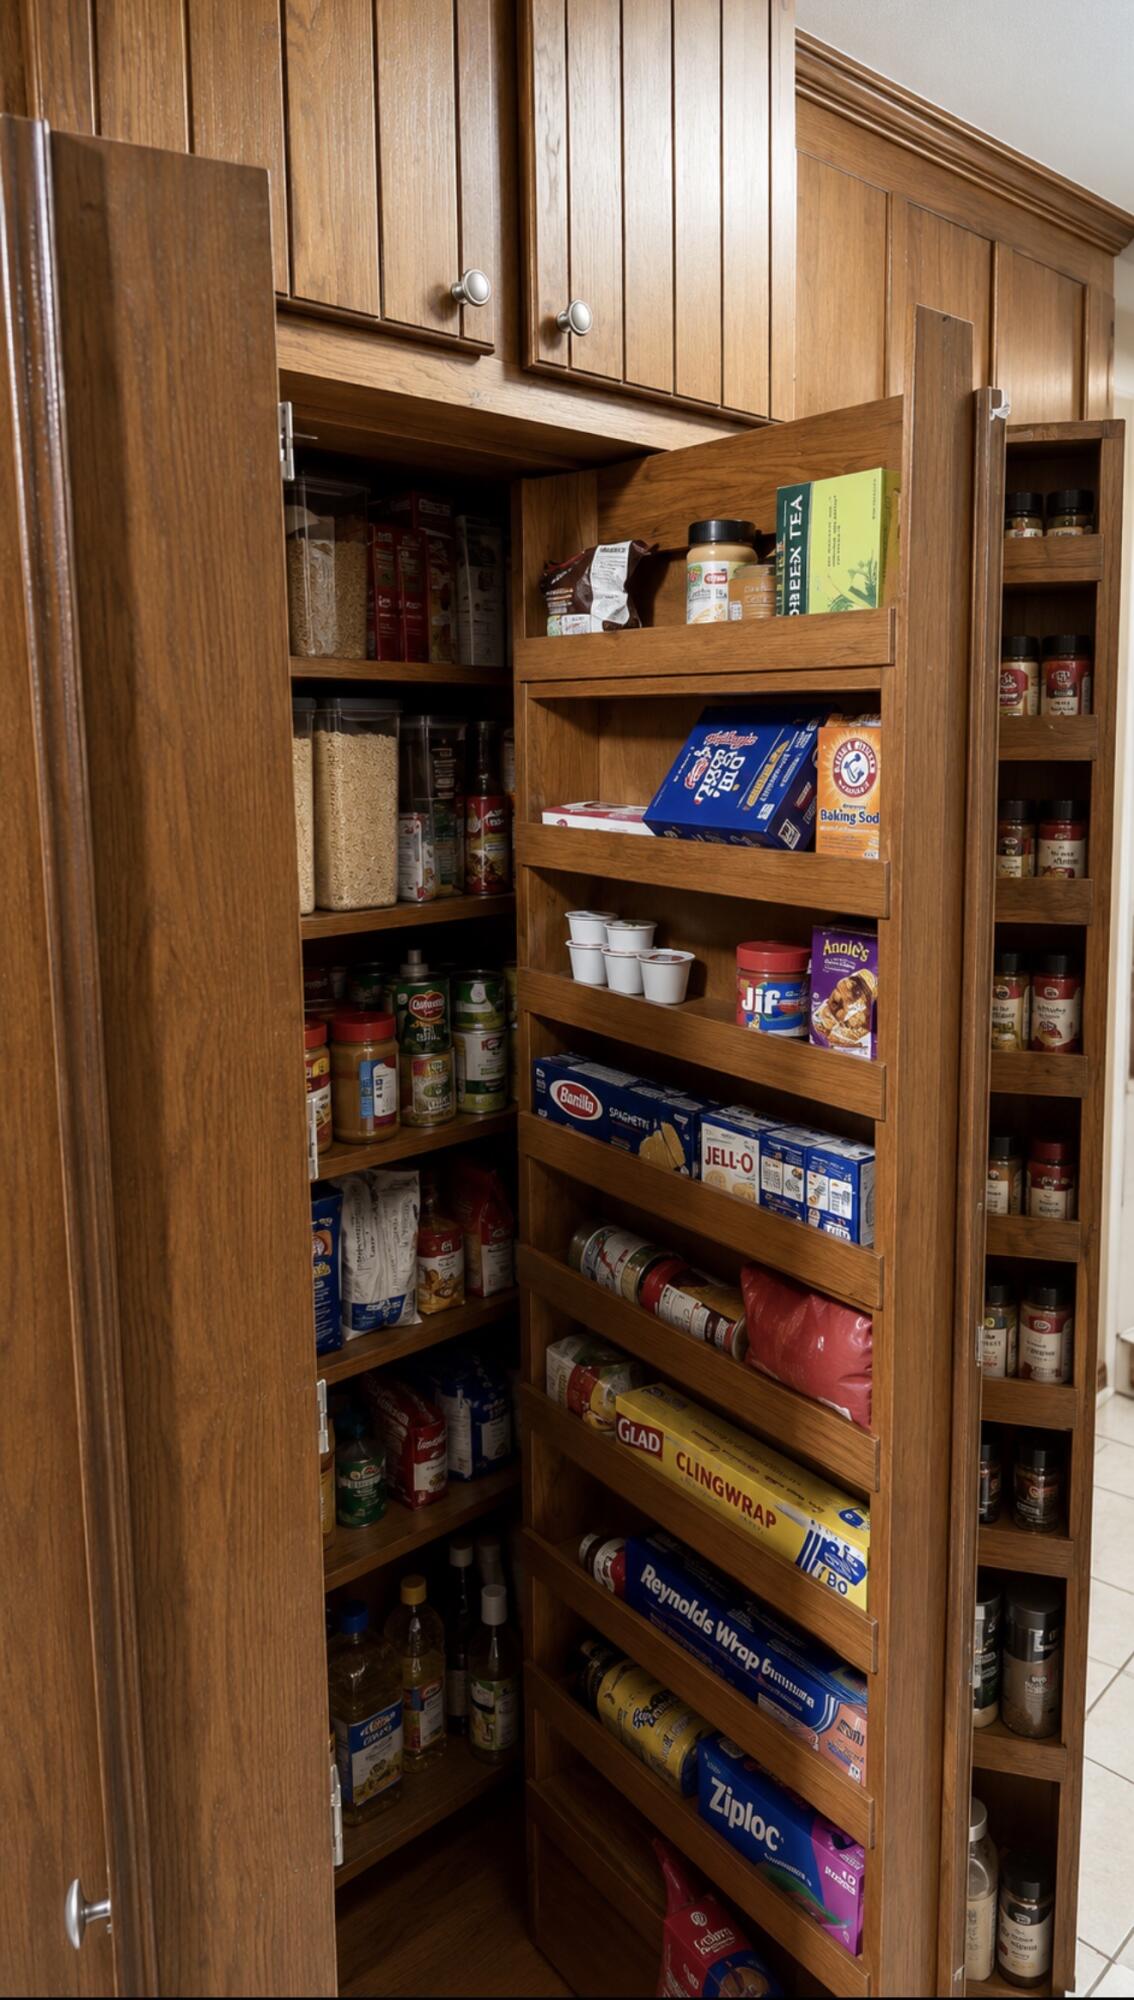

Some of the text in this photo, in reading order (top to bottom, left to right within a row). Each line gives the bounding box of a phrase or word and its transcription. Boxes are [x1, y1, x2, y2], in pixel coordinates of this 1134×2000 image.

[789, 494, 803, 540] TEA
[820, 809, 880, 825] Baking Sod
[742, 986, 781, 1014] Jif
[705, 1146, 753, 1174] JELL-O
[617, 1418, 662, 1453] GLAD
[676, 1451, 777, 1529] CLINGWRAP
[640, 1563, 761, 1671] Reynolds Wrap
[709, 1776, 781, 1852] Ziploc
